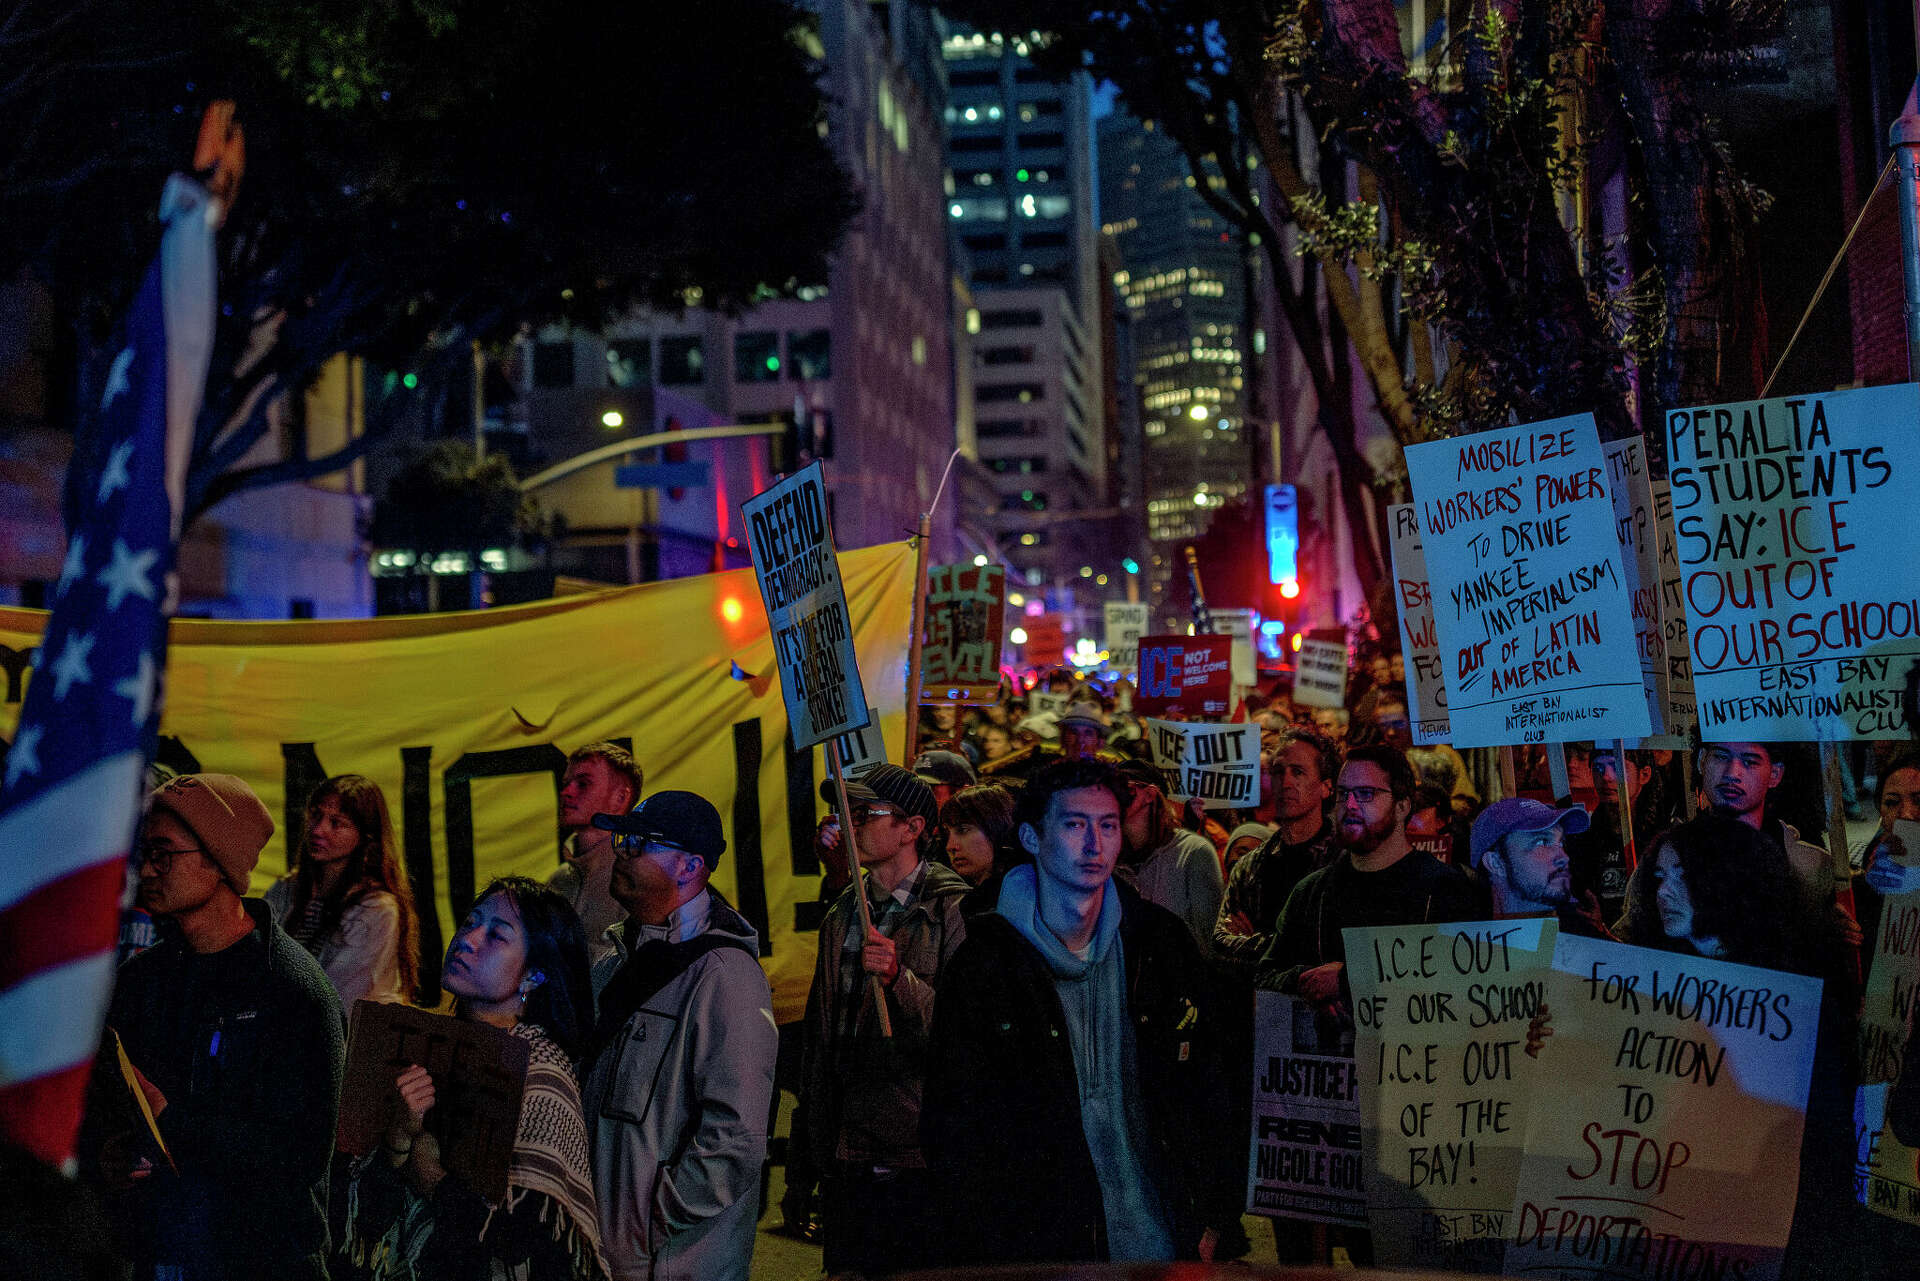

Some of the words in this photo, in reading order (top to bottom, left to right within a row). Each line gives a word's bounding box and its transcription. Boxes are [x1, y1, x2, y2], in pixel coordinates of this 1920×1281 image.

[1670, 400, 1831, 461] PERALTA
[1457, 429, 1576, 482] MOBILIZE
[1608, 444, 1641, 481] THE
[1671, 447, 1892, 509] STUDENTS
[1425, 476, 1524, 535] WORKERS'
[1536, 467, 1606, 514] POWER
[751, 479, 825, 573] DEFEND
[1501, 514, 1572, 558] DRIVE
[1679, 511, 1767, 563] SAY:
[1780, 501, 1856, 557] ICE
[764, 545, 833, 612] DEMOCRACY:
[928, 565, 1004, 604] ICE
[1450, 558, 1535, 620] YANKEE
[1482, 558, 1619, 640] IMPERIALISM
[1687, 563, 1777, 617] OUT
[1785, 557, 1839, 600] OF
[777, 623, 802, 668] IT'S
[798, 612, 822, 658] TIME
[816, 602, 845, 648] FOR
[1458, 638, 1491, 681] OUT
[1502, 637, 1520, 664] OF
[1535, 610, 1601, 659] LATIN
[1694, 619, 1784, 669] OUR
[793, 664, 806, 701] A
[801, 645, 845, 696] GENERAL
[922, 641, 1001, 685] EVIL
[1140, 646, 1184, 698] ICE
[1184, 649, 1212, 664] NOT
[1184, 661, 1228, 676] WELCOME
[1491, 651, 1582, 698] AMERICA
[1760, 661, 1823, 691] EAST
[1836, 657, 1890, 683] BAY
[808, 685, 848, 735] STRIKE!
[1505, 707, 1609, 732] INTERNATIONALIST
[1512, 701, 1537, 714] EAST
[1543, 695, 1561, 710] BAY
[1703, 689, 1906, 729] INTERNATIONALIST
[1159, 727, 1185, 764] ICE
[1194, 730, 1245, 765] OUT
[1523, 731, 1545, 743] CLUB
[1188, 768, 1253, 802] GOOD!
[1374, 936, 1438, 983] I.C.E
[1452, 927, 1522, 975] OUT
[1358, 997, 1388, 1030] OF
[1407, 992, 1457, 1025] OUR
[1584, 962, 1640, 1015] FOR
[1653, 970, 1792, 1042] WORKERS
[1261, 1057, 1344, 1101] JUSTICE
[1378, 1042, 1438, 1085] I.C.E
[1463, 1040, 1520, 1086] OUT
[1616, 1026, 1726, 1087] ACTION
[1400, 1102, 1434, 1139] OF
[1456, 1099, 1512, 1138] THE
[1618, 1084, 1653, 1124] TO
[1257, 1145, 1326, 1186] NICOLE
[1409, 1141, 1477, 1190] BAY!
[1567, 1121, 1690, 1194] STOP
[1470, 1213, 1504, 1236] BAY
